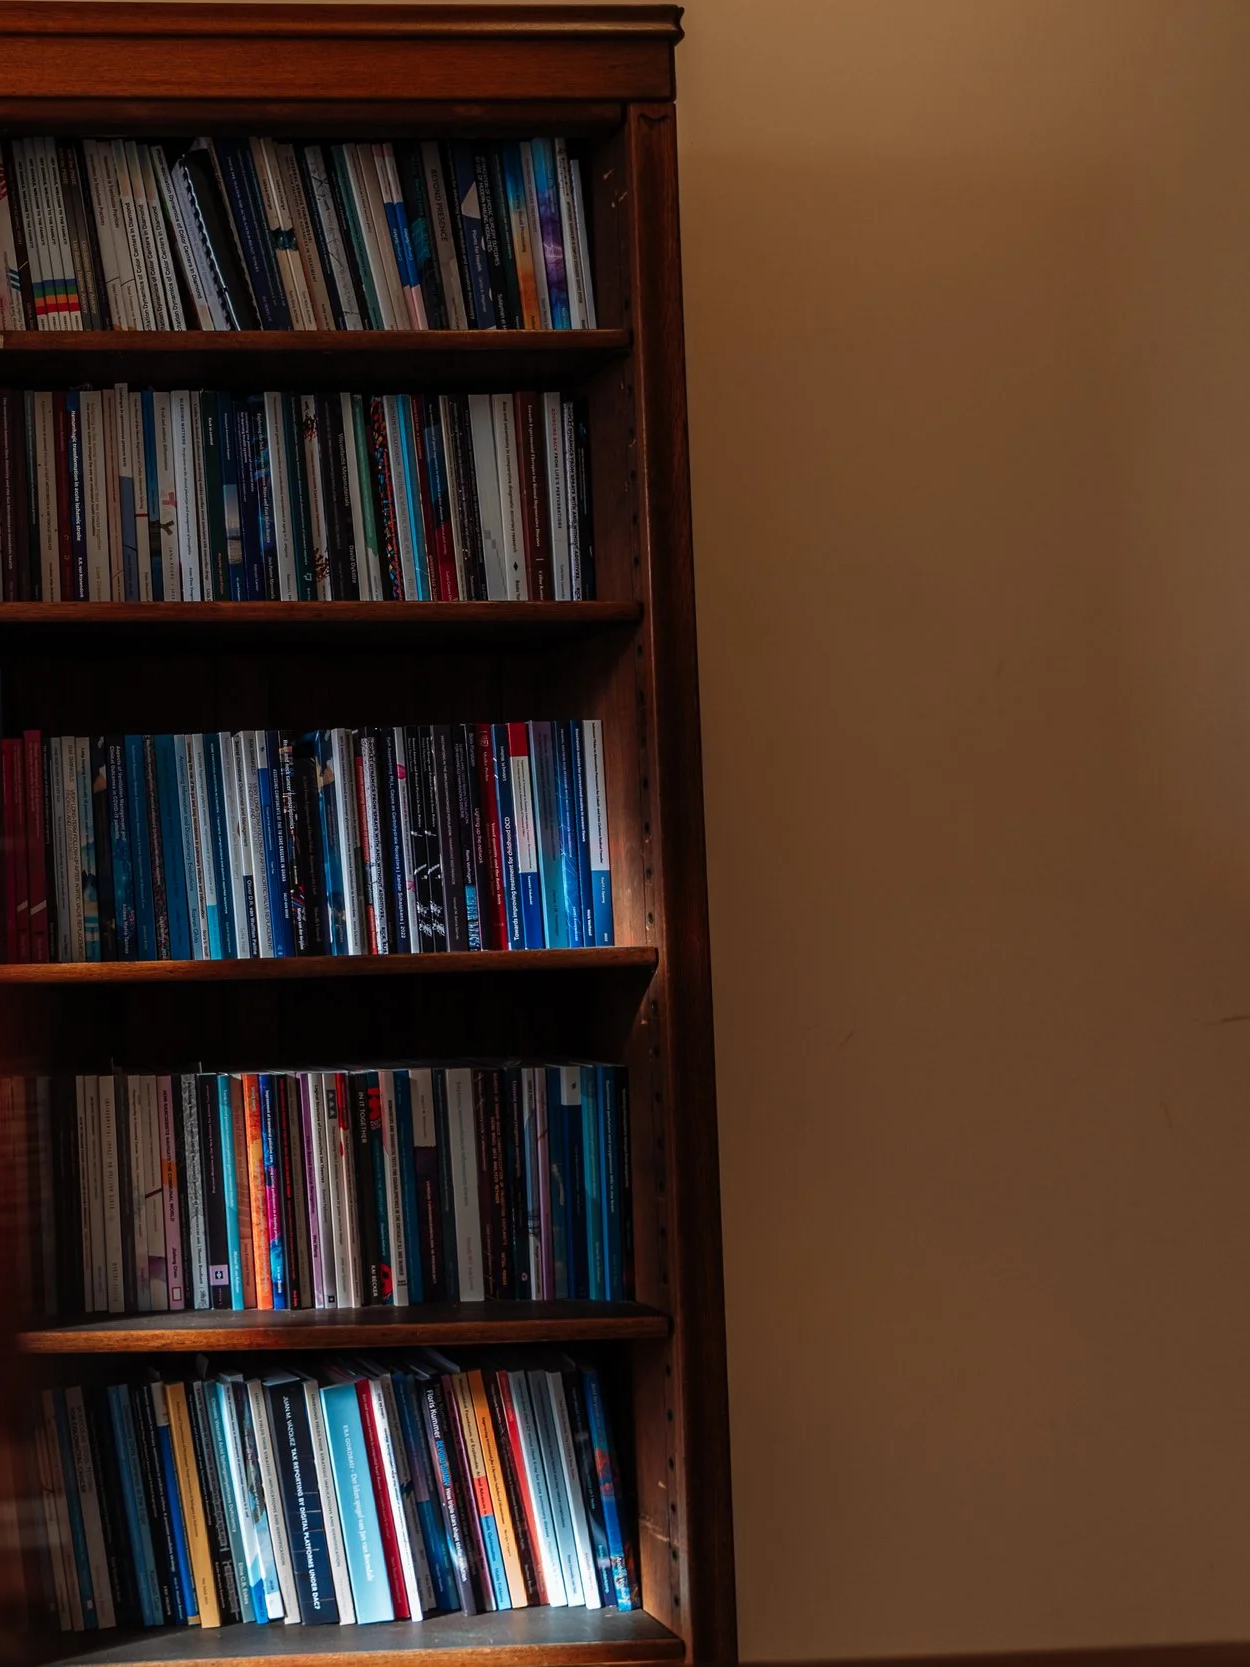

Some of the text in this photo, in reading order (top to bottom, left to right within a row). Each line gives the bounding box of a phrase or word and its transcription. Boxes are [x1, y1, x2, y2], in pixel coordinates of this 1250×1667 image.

[125, 202, 134, 227] Diamond
[138, 204, 147, 229] Diamond
[430, 168, 447, 241] BEYOND PRESENCE
[151, 205, 161, 230] Diamond
[130, 234, 139, 256] Centers
[144, 236, 153, 258] Centers
[158, 236, 167, 259] Centers
[168, 194, 180, 221] Dynamics
[178, 229, 186, 244] Color
[182, 245, 193, 267] Centers
[190, 274, 202, 299] Diamond
[134, 257, 142, 273] Color
[148, 259, 156, 275] Color
[162, 259, 170, 275] Color
[138, 281, 148, 308] Dynamics
[152, 283, 162, 311] Dynamics
[167, 282, 178, 309] Dynamics
[338, 433, 350, 506] Viscoelastic Metamaterials
[349, 562, 357, 582] Dykstra
[178, 756, 186, 784] Accounting
[180, 785, 188, 814] Information
[286, 792, 295, 829] transcriptomics
[184, 827, 192, 860] Discretionary
[505, 829, 513, 855] childhood
[186, 862, 194, 891] Evaluations
[508, 864, 516, 889] treatment
[510, 891, 518, 917] improving
[512, 918, 520, 940] Towards
[359, 1109, 367, 1143] TOGETHER
[282, 1395, 290, 1411] JUAN
[425, 1389, 435, 1408] Floris
[429, 1408, 440, 1438] Kummer
[292, 1461, 303, 1496] REPORTING
[444, 1487, 452, 1499] How
[299, 1507, 308, 1530] DIGITAL
[447, 1500, 455, 1513] triple
[449, 1513, 457, 1526] stars
[452, 1526, 460, 1541] shape
[303, 1531, 314, 1568] PLATFORMS
[308, 1569, 317, 1591] UNDER
